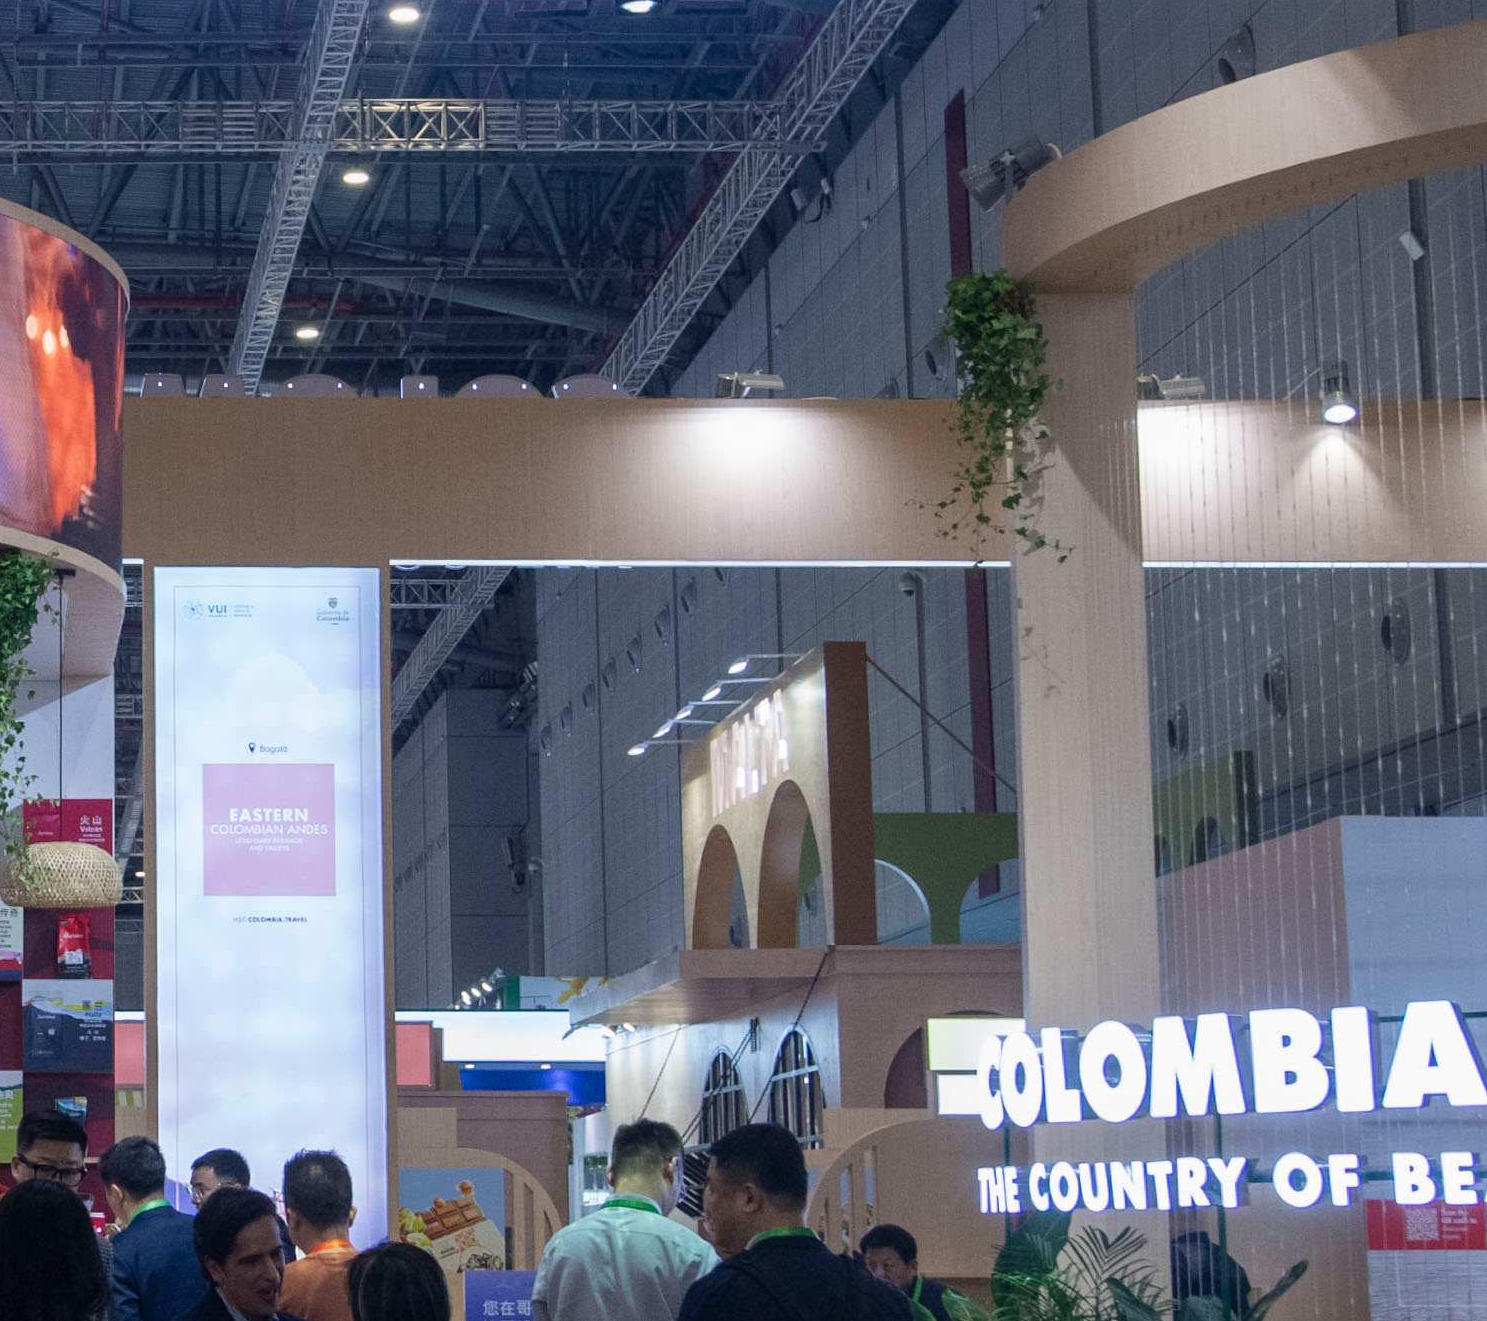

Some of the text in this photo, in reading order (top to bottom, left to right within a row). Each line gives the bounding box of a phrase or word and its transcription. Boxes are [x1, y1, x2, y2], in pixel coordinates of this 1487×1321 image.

[229, 807, 309, 823] EASTERN
[210, 824, 329, 836] COLOMBIAN ANDES
[977, 1166, 1019, 1214] THE
[1029, 1156, 1246, 1213] COUNTRY
[1273, 1152, 1359, 1208] OF
